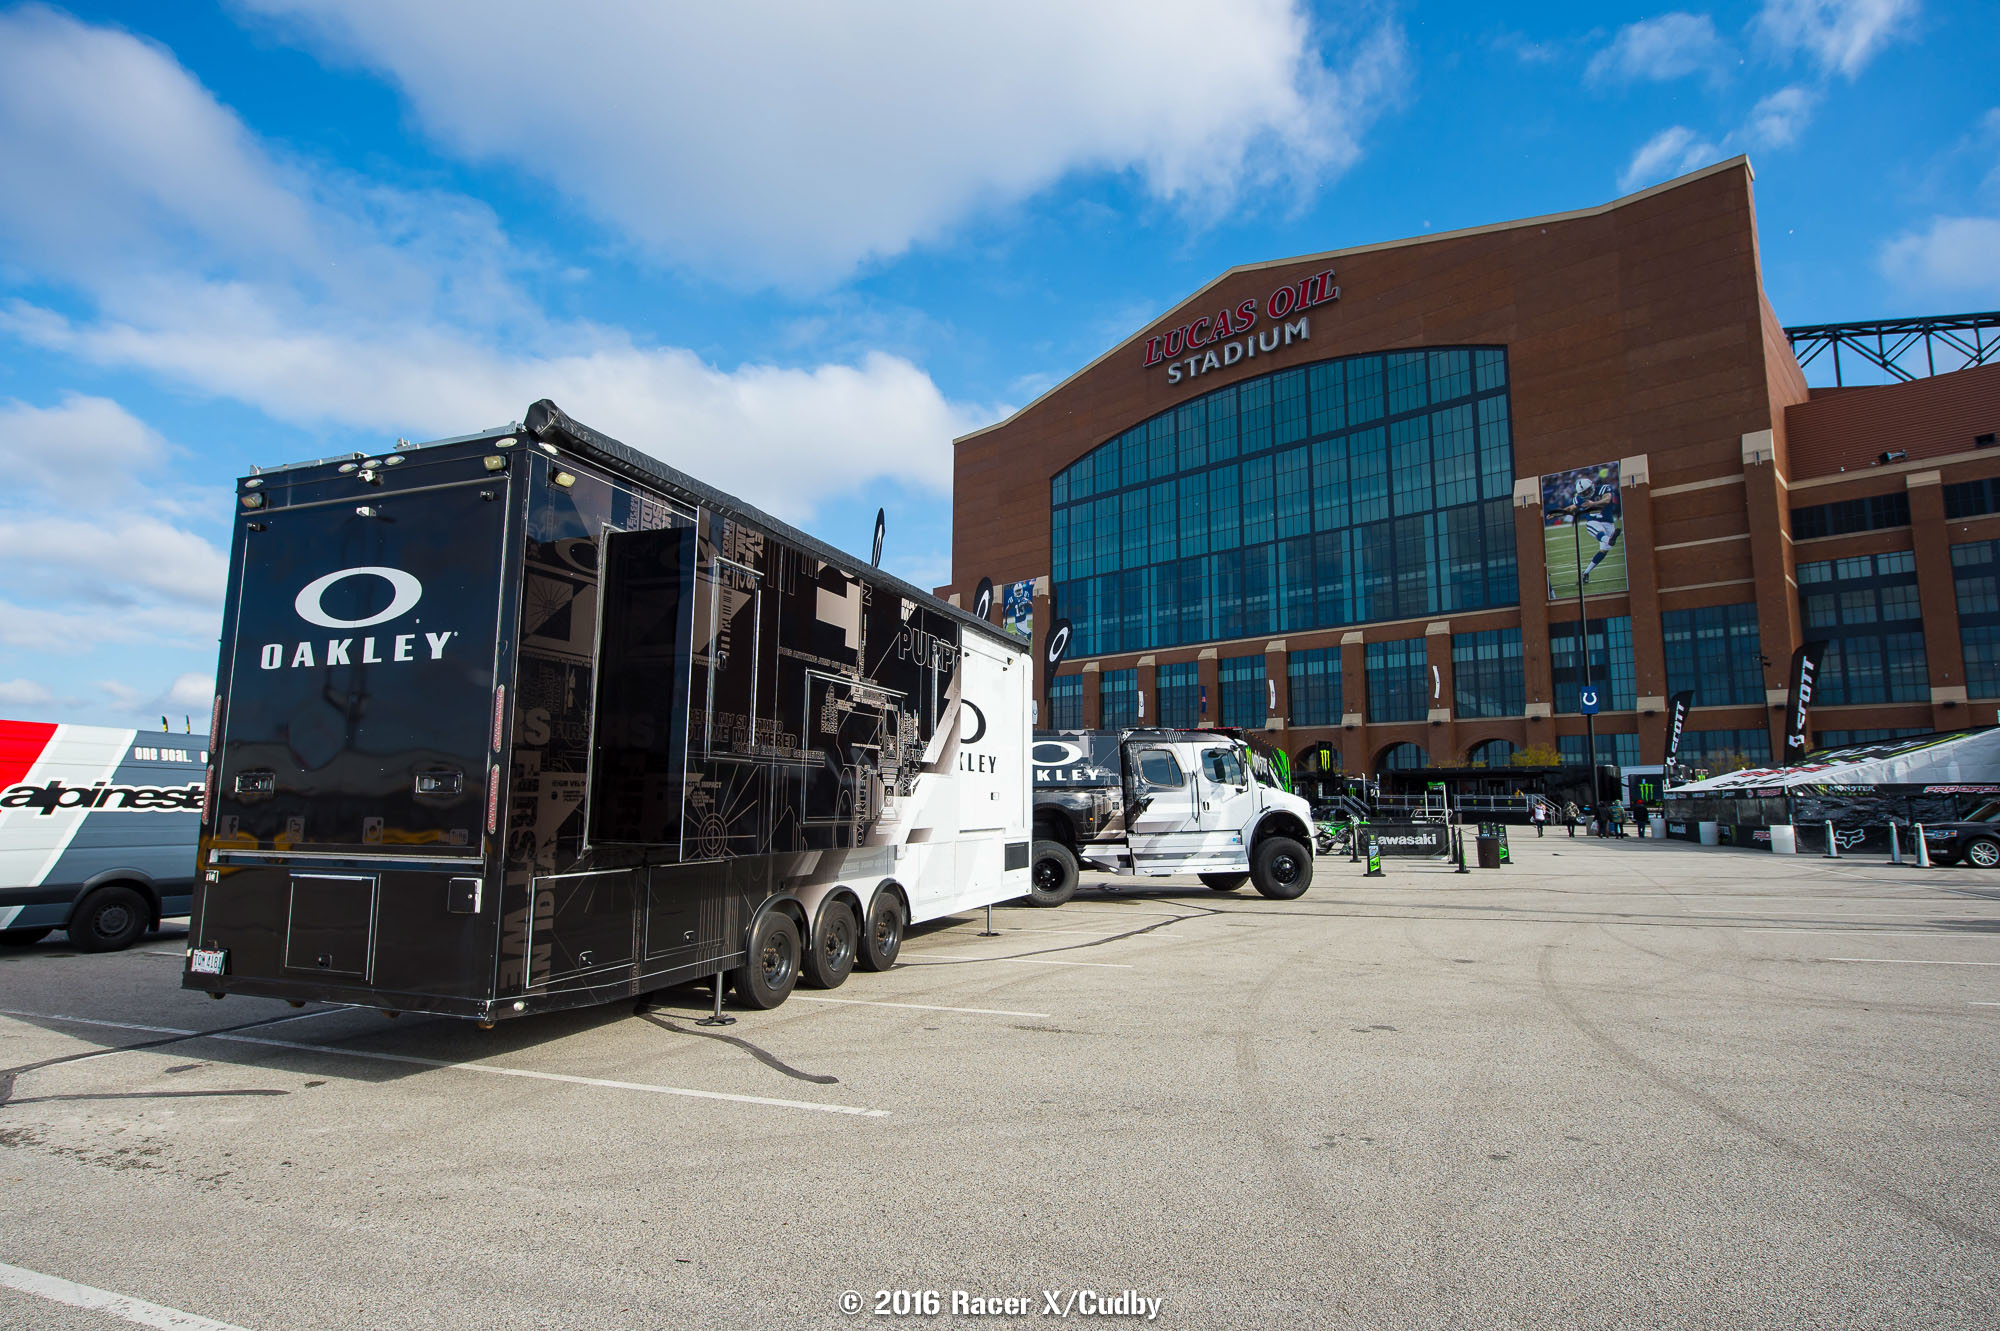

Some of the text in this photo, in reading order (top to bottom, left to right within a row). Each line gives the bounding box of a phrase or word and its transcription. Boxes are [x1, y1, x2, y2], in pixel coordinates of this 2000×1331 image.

[1143, 268, 1340, 367] LUCAS OIL
[1168, 316, 1310, 384] STADIUM
[260, 631, 453, 670] OAKLEY
[1797, 655, 1815, 730] SCOTT
[732, 726, 798, 749] MASTERED
[1671, 700, 1685, 753] SCOTT
[134, 747, 158, 761] one
[161, 748, 193, 763] goal.
[1037, 769, 1100, 781] KLEY
[1923, 785, 1958, 794] PRO
[1377, 833, 1437, 845] awasaki
